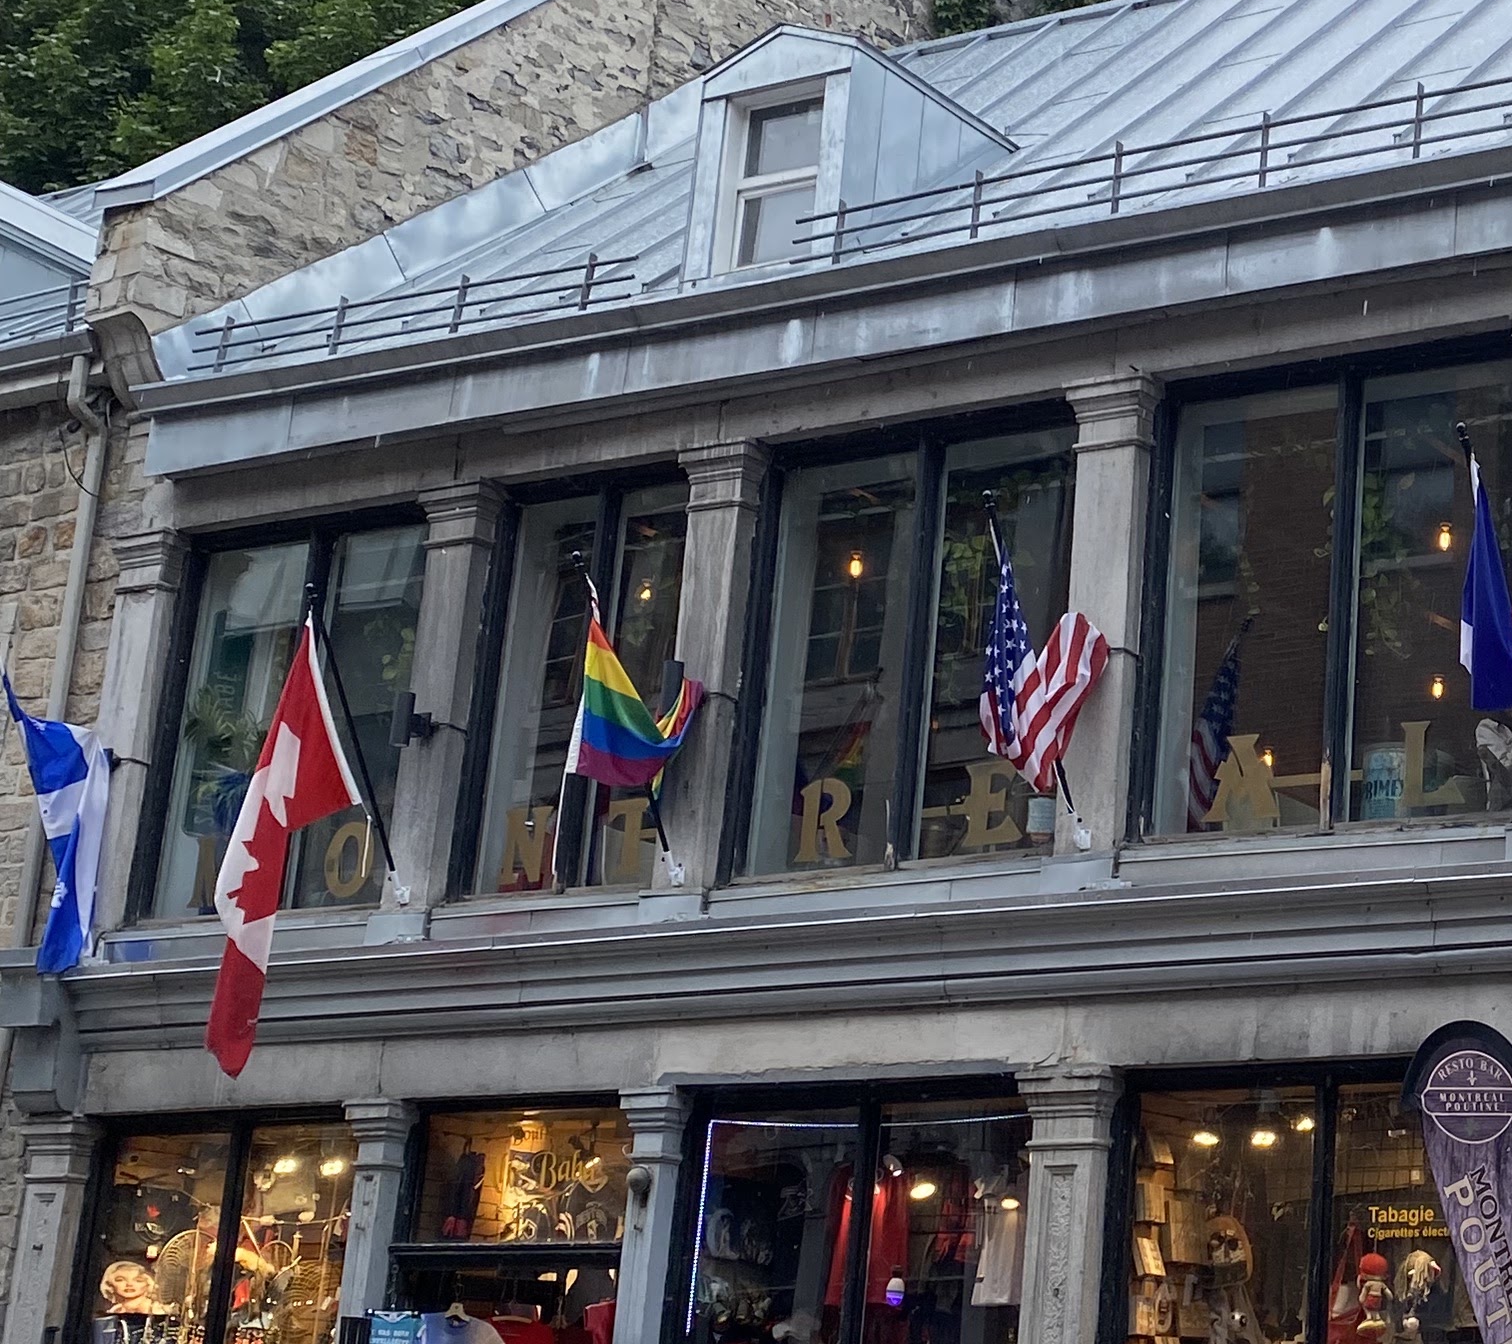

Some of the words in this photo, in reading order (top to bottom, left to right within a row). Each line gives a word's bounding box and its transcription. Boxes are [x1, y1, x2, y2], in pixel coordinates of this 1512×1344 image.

[1437, 1057, 1474, 1081] RESTO
[1479, 1059, 1503, 1081] BAR
[1439, 1092, 1506, 1103] MONTREAL
[1445, 1102, 1501, 1112] POUTINE
[1368, 1205, 1434, 1226] Tabagie
[1368, 1227, 1420, 1240] Cigarettes
